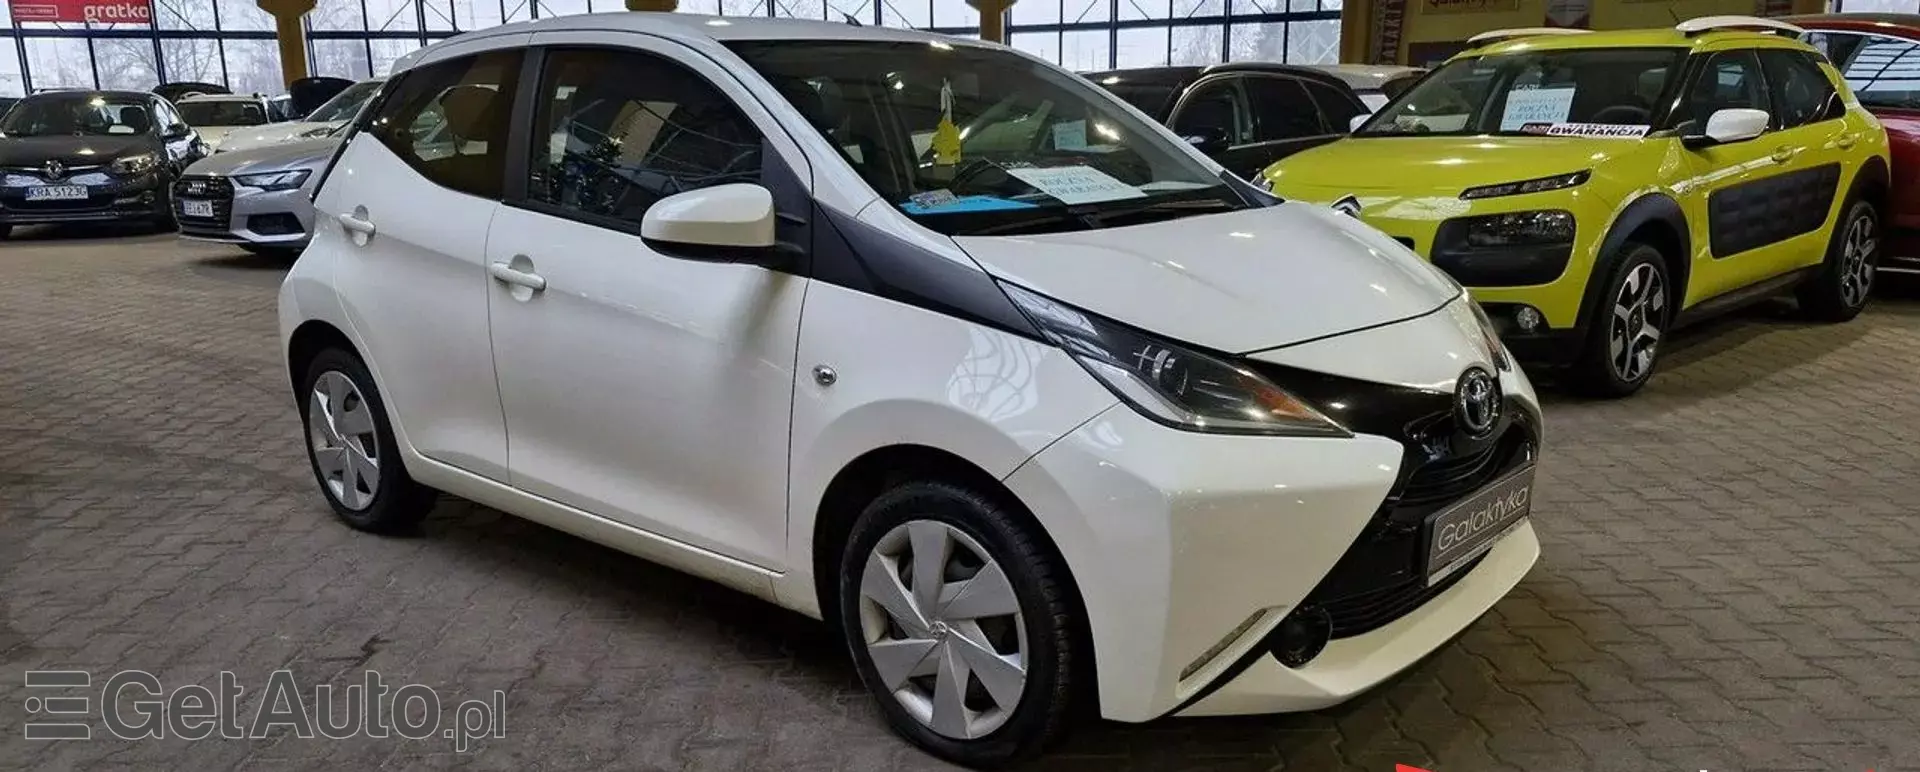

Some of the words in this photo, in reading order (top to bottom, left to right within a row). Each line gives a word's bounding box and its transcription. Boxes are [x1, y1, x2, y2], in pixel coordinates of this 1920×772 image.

[84, 3, 149, 24] gratka
[1549, 126, 1644, 137] GWARANCJA
[1438, 486, 1529, 551] Galaktyka
